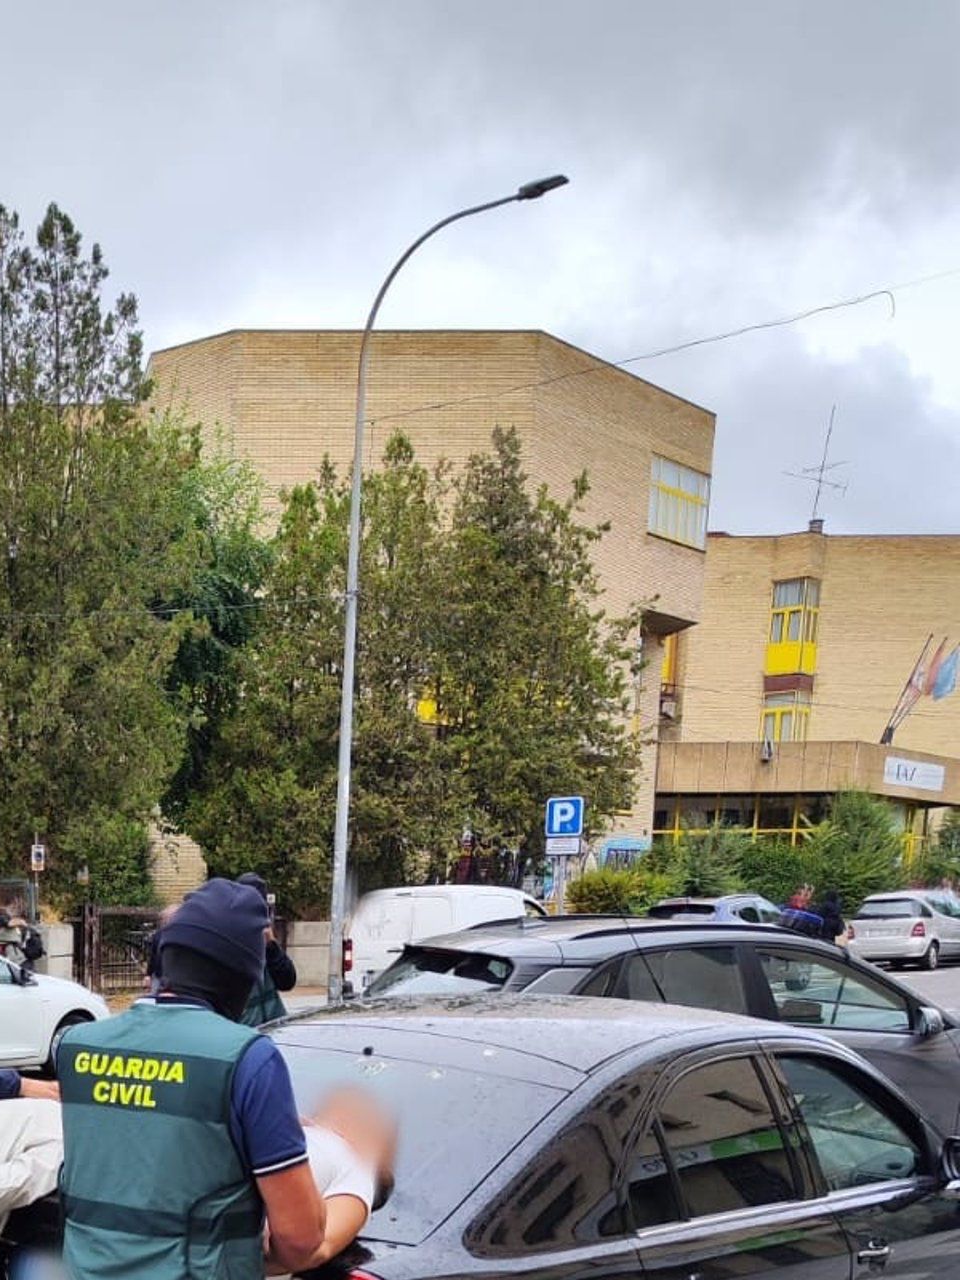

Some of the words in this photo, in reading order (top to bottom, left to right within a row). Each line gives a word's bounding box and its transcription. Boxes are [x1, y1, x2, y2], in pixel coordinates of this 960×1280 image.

[553, 802, 575, 833] P
[74, 1051, 185, 1083] GUARDIA
[93, 1081, 156, 1107] CIVIL
